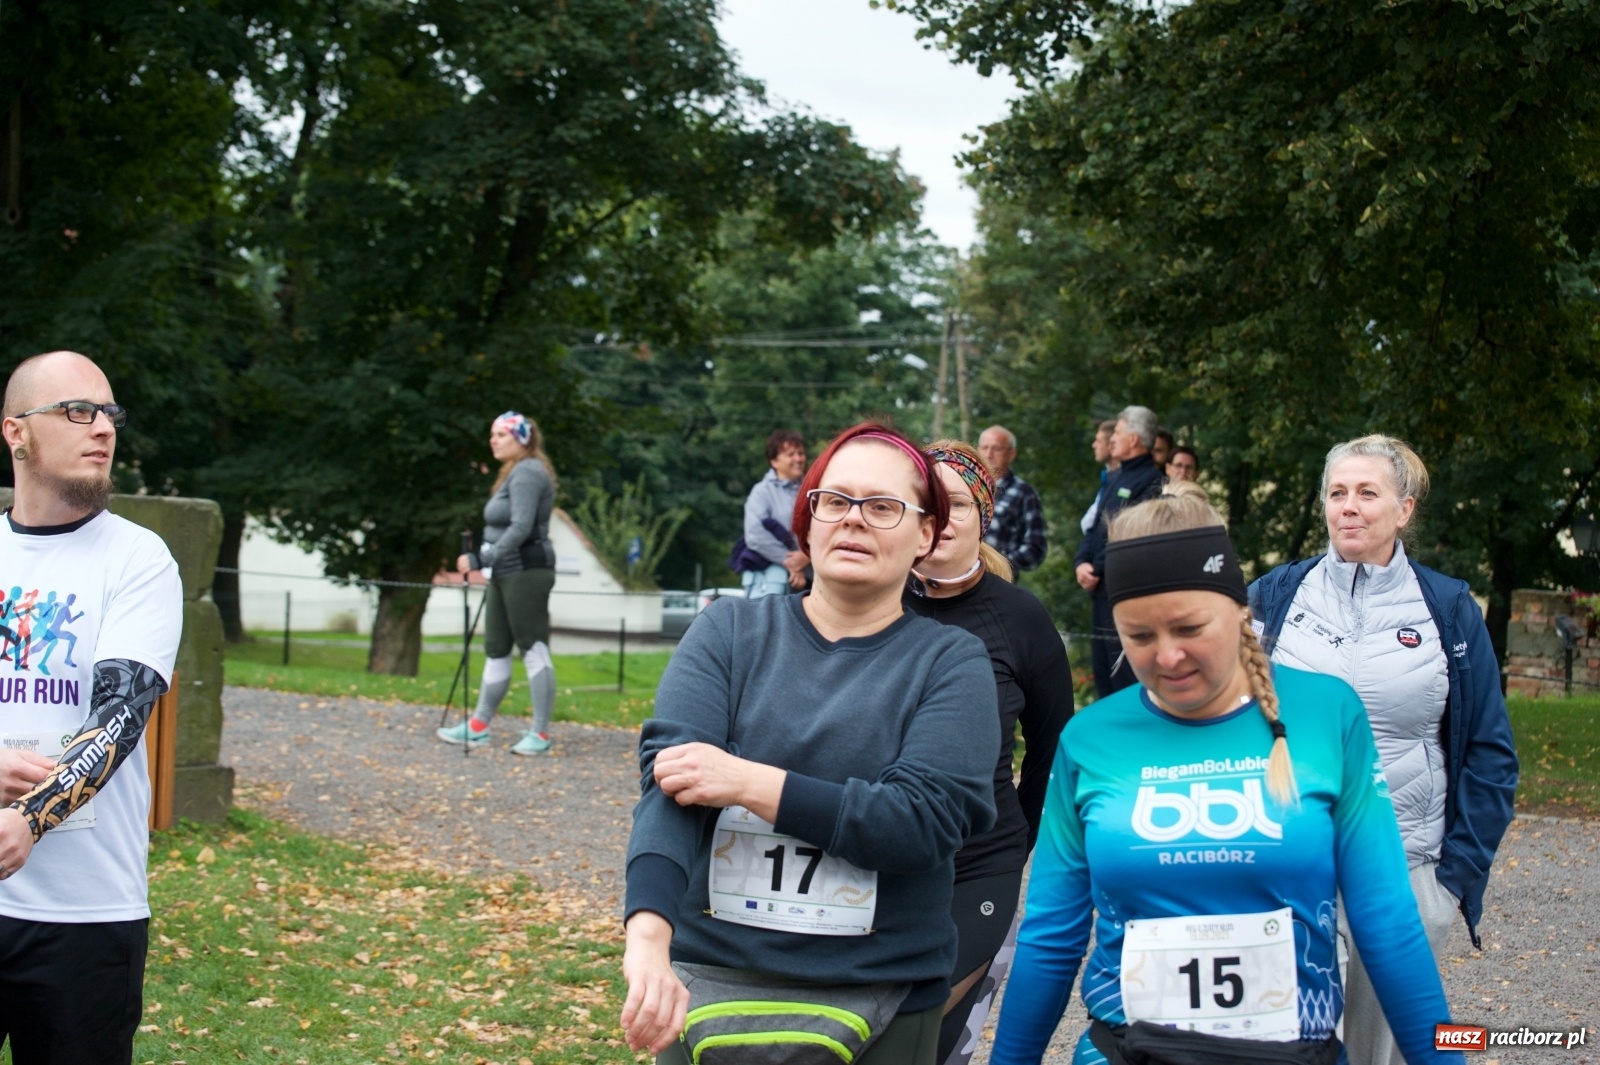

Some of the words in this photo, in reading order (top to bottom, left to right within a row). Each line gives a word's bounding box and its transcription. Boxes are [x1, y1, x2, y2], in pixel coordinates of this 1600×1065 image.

[1203, 554, 1224, 573] 4F
[34, 678, 79, 706] RUN
[58, 705, 132, 791] SMMASH
[1131, 778, 1283, 842] bbl
[764, 844, 823, 894] 17
[1158, 847, 1256, 865] RACIBÓRZ
[1178, 956, 1244, 1009] 15
